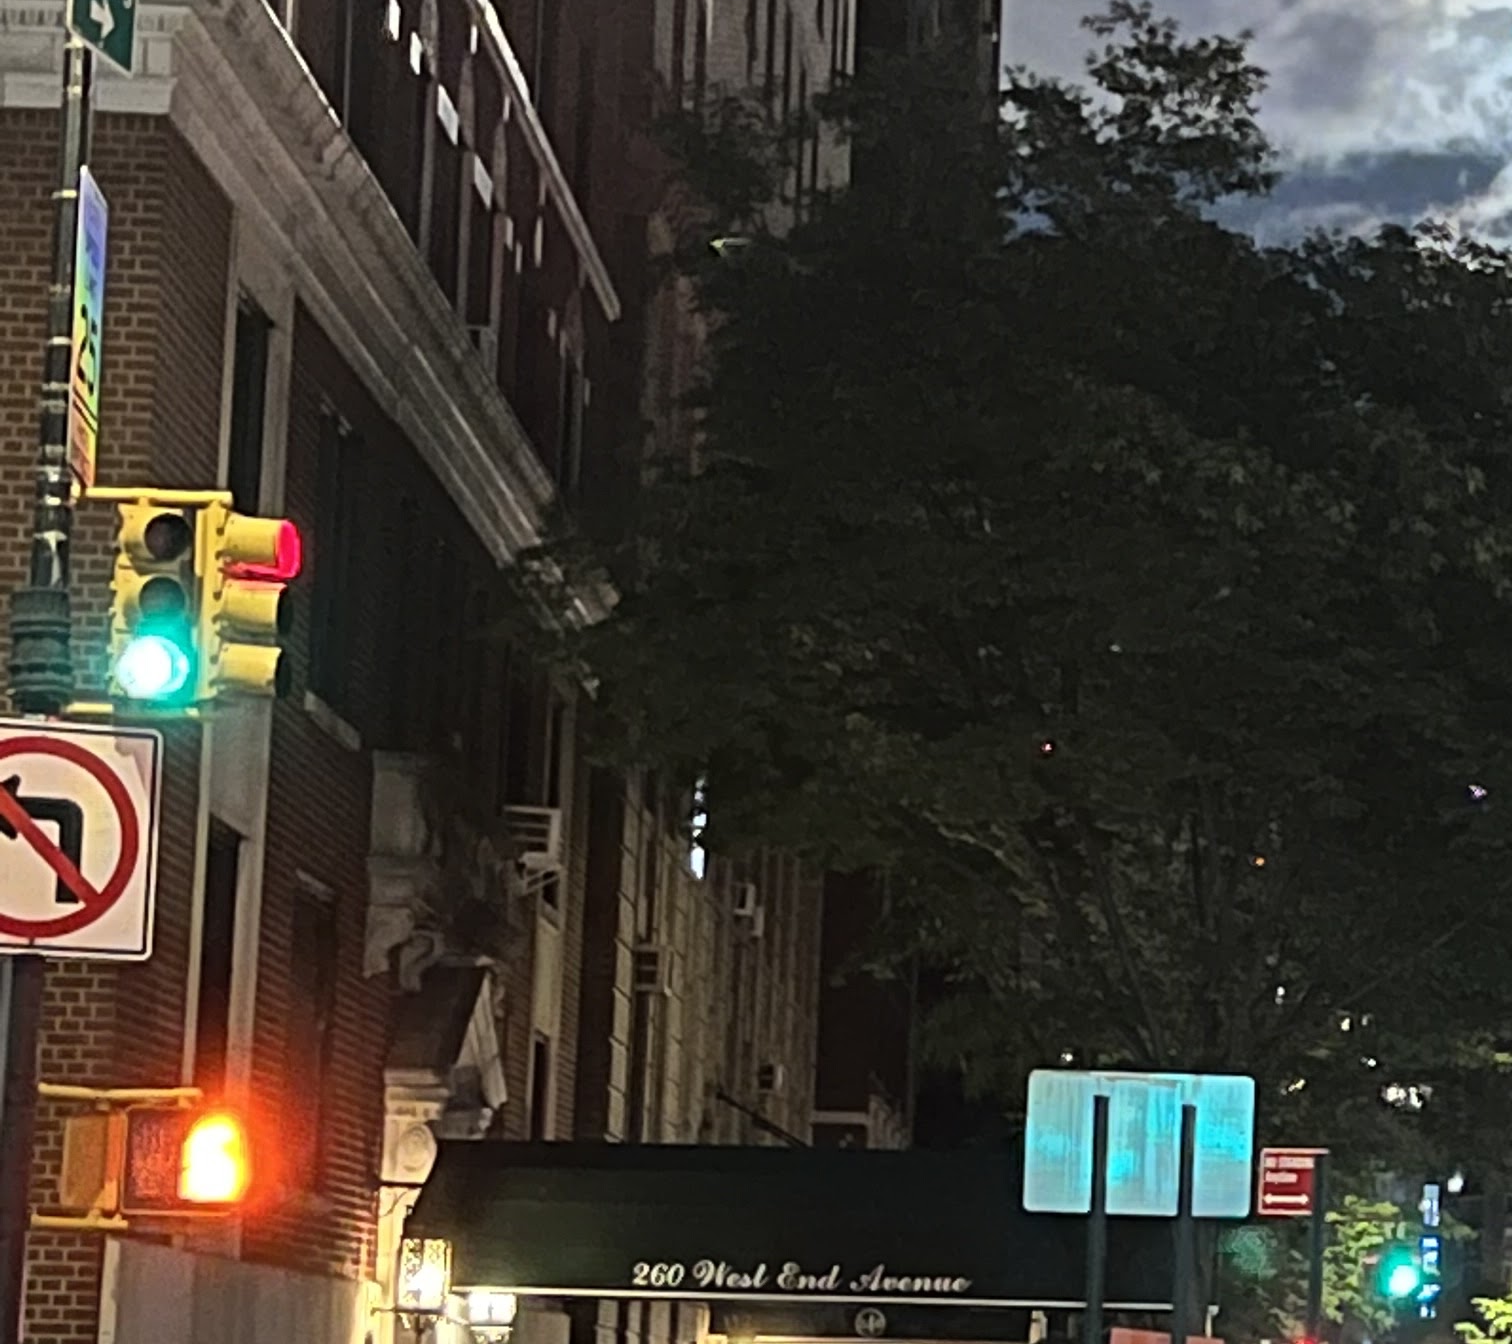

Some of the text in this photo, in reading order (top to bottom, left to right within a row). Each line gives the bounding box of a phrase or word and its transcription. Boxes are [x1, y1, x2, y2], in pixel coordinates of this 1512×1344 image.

[632, 1259, 972, 1292] 260 West End Avenue
